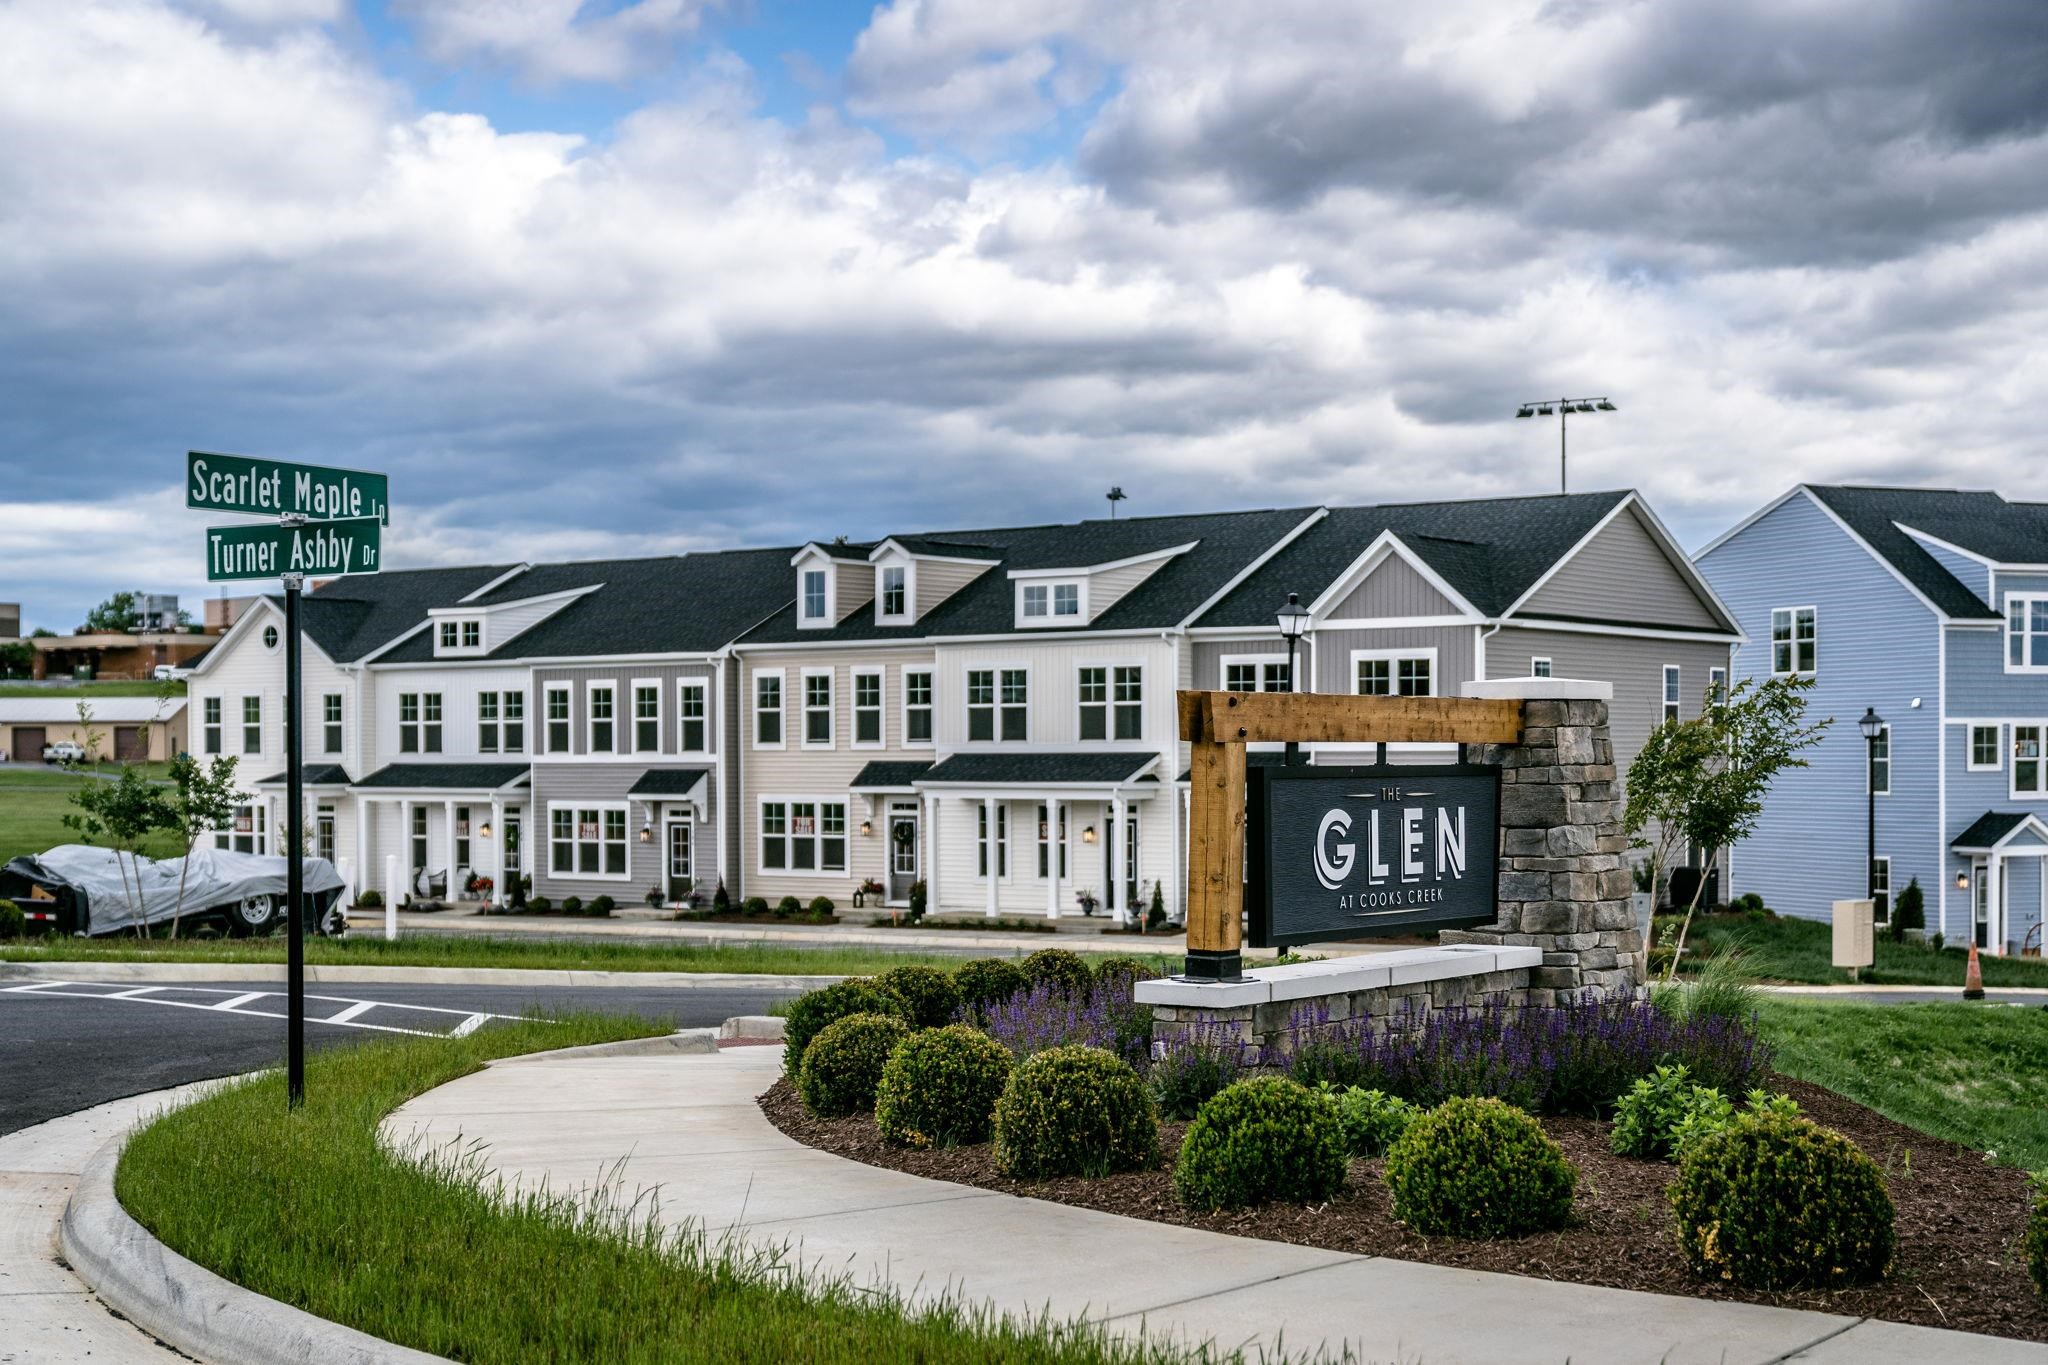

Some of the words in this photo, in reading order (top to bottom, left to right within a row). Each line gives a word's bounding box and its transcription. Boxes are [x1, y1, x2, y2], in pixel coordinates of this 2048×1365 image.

[192, 459, 281, 509] Scarlet
[295, 471, 362, 519] Maple
[211, 535, 278, 574] Turner
[290, 528, 353, 574] Ashby
[363, 545, 376, 565] Dr
[1382, 787, 1401, 801] THE
[1313, 806, 1466, 890] GLEN
[1340, 895, 1353, 909] AT
[1360, 891, 1402, 908] COOKS
[1408, 888, 1443, 904] CREEK
